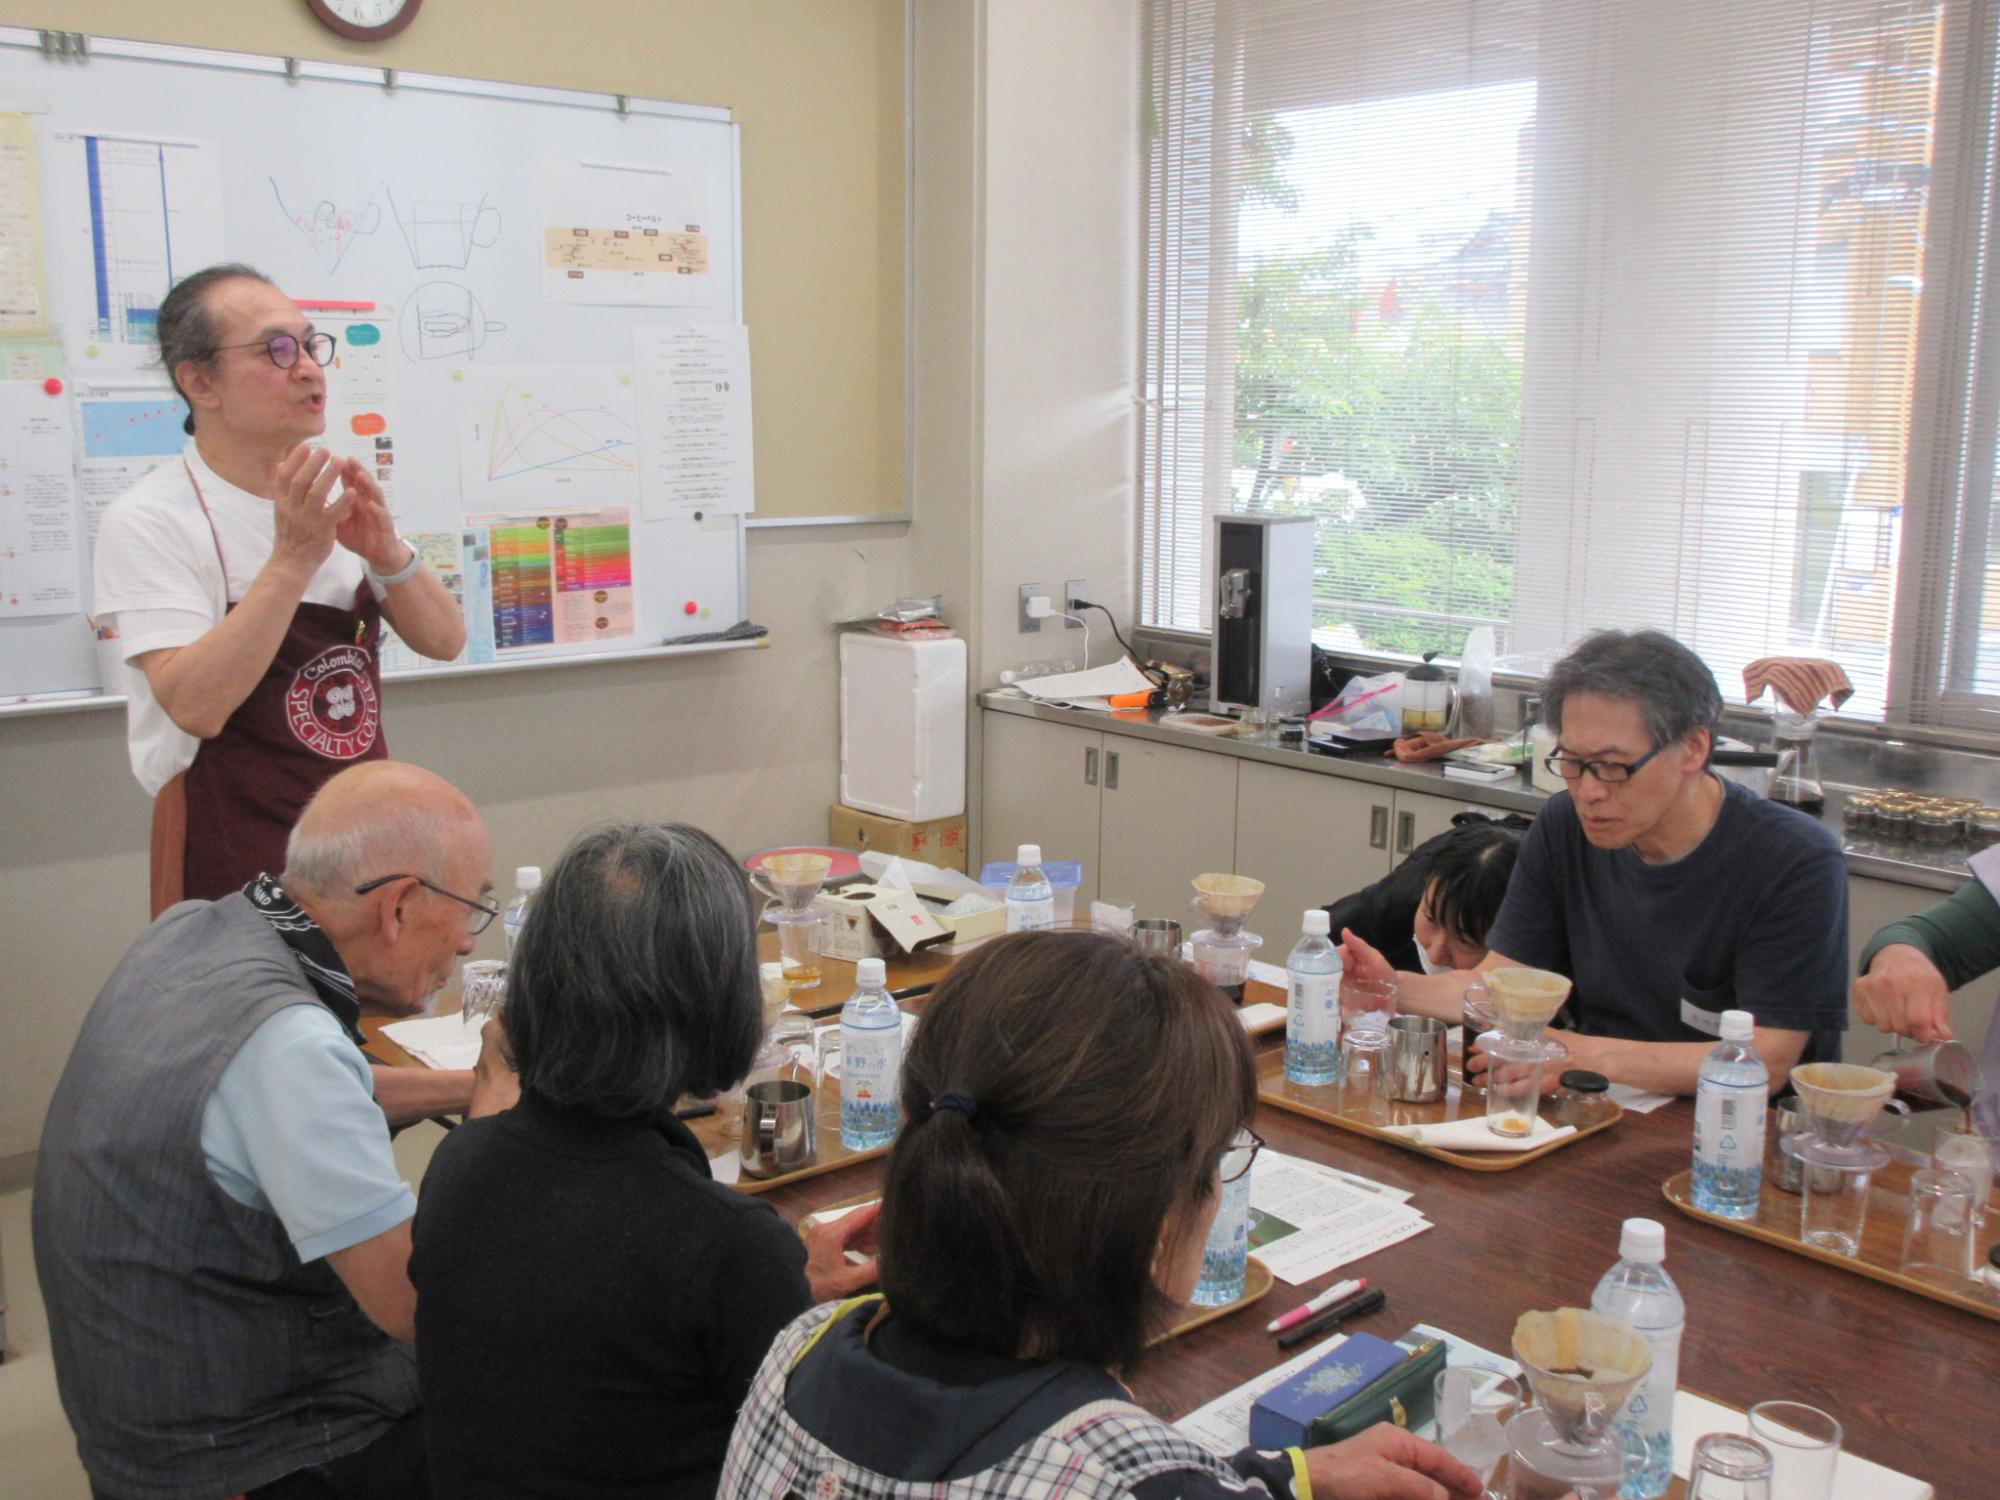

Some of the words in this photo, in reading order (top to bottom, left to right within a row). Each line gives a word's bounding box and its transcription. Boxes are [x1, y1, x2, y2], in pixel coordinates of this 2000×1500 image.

[353, 6, 364, 19] 6
[303, 649, 366, 680] Colombia
[290, 687, 355, 756] SPECIALTY
